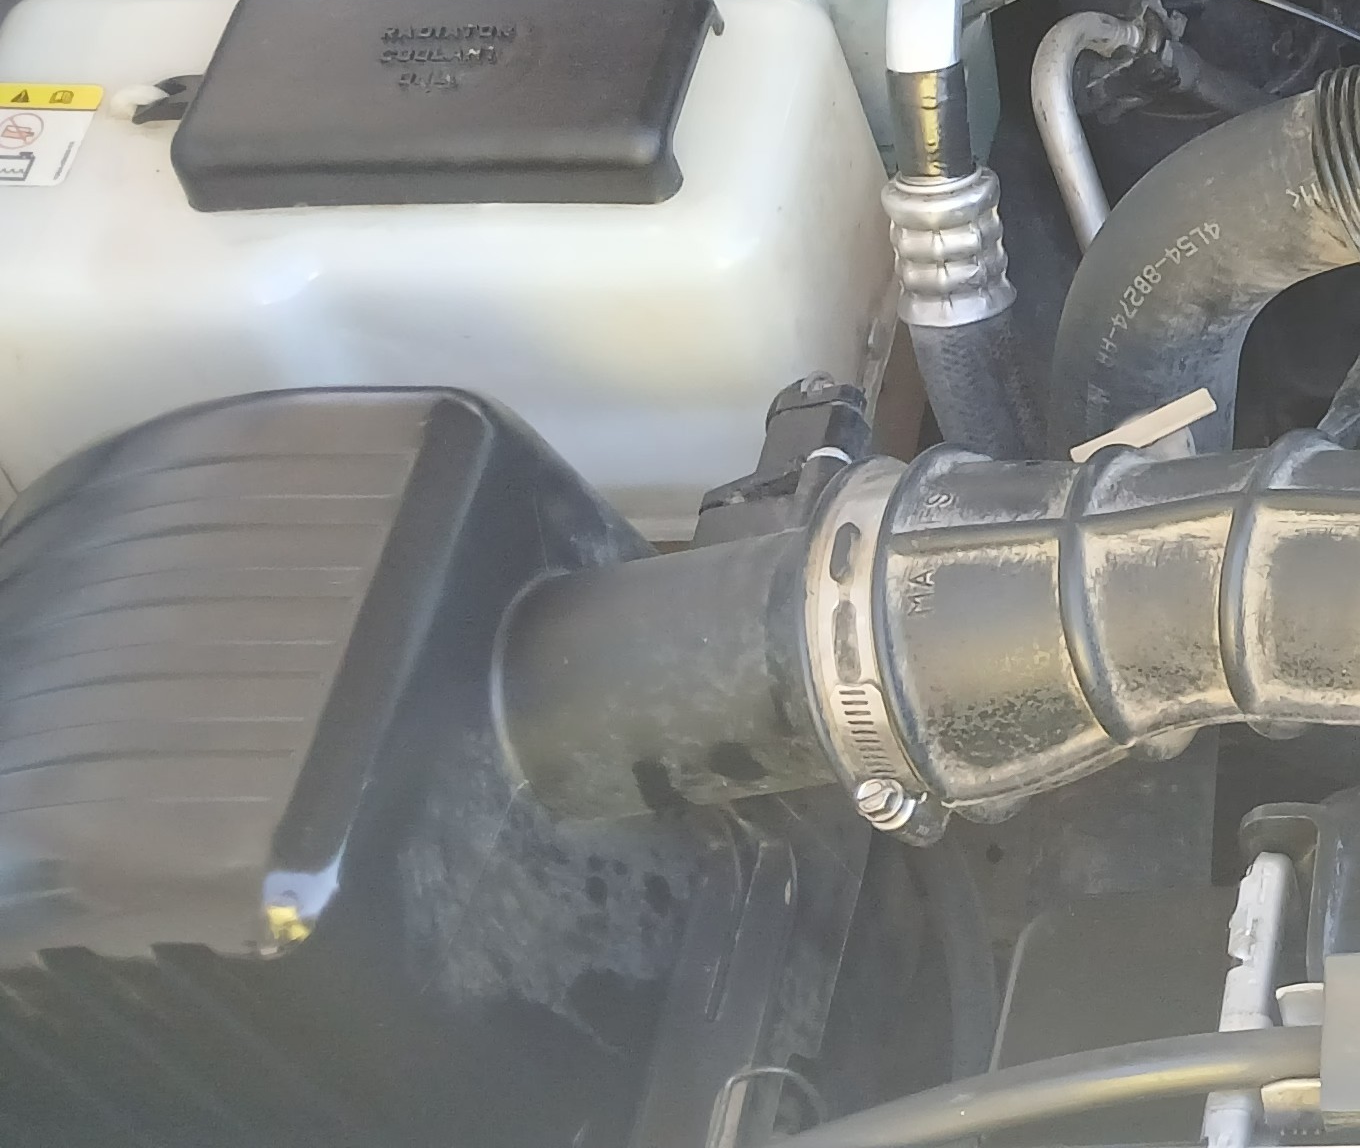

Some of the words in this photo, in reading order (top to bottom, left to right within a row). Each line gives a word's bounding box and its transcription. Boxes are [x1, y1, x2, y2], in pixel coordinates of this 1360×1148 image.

[380, 24, 516, 40] RADIATOR
[380, 46, 497, 64] COOLANT
[399, 73, 458, 89] ONLY
